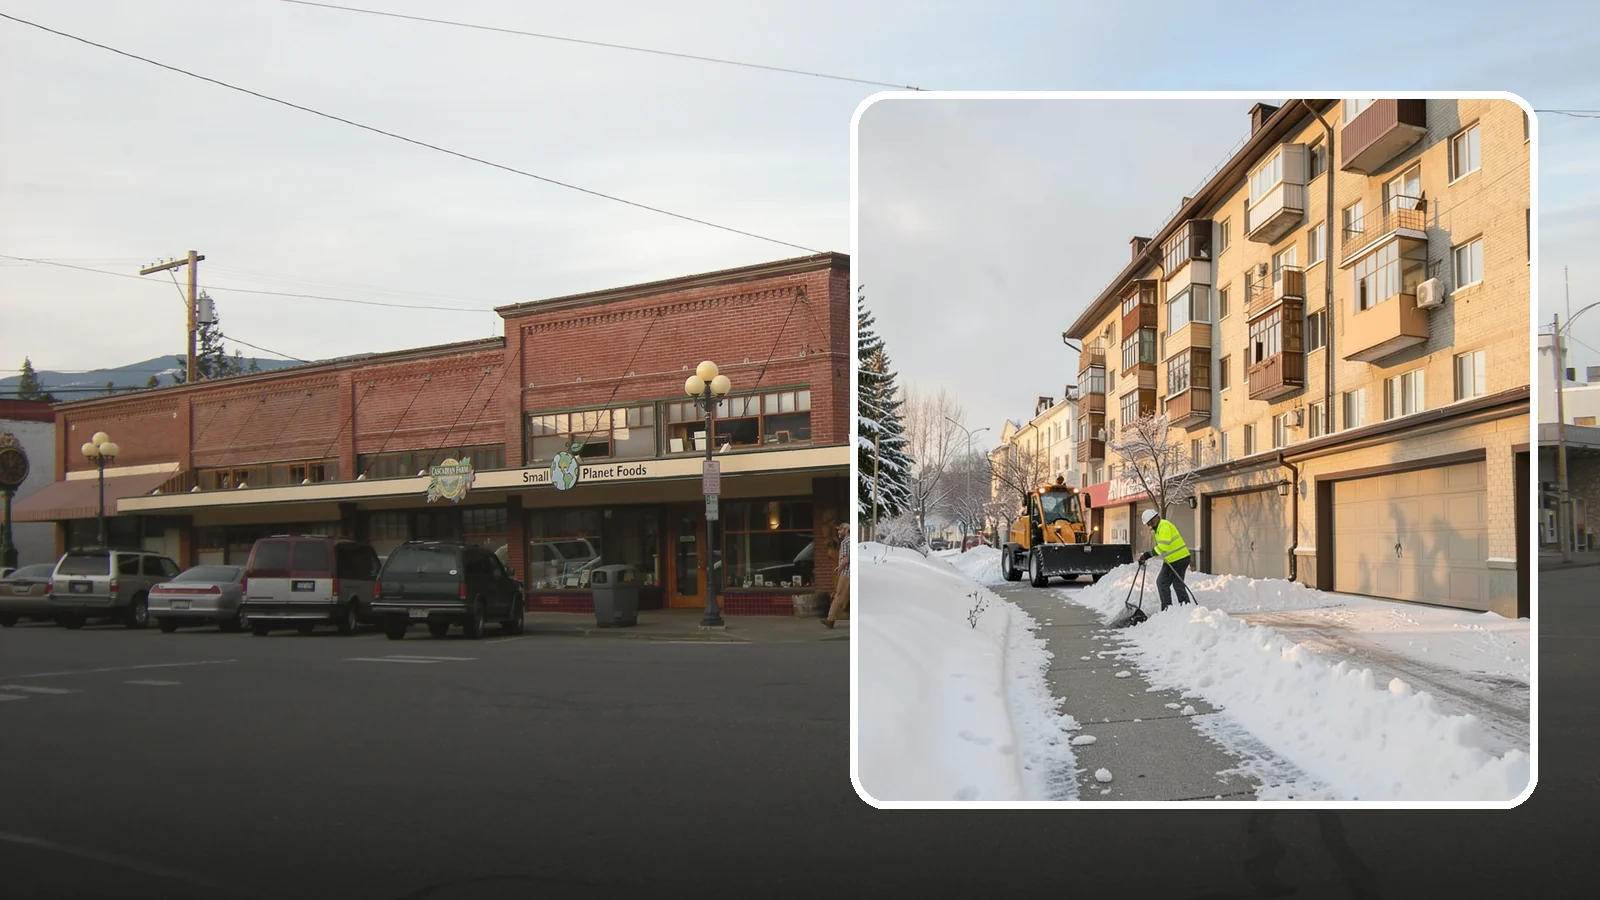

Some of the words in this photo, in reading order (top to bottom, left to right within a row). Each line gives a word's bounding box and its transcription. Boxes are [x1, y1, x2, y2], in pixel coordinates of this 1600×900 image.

[523, 471, 549, 483] Small
[582, 467, 614, 479] Planet
[617, 464, 647, 477] Foods
